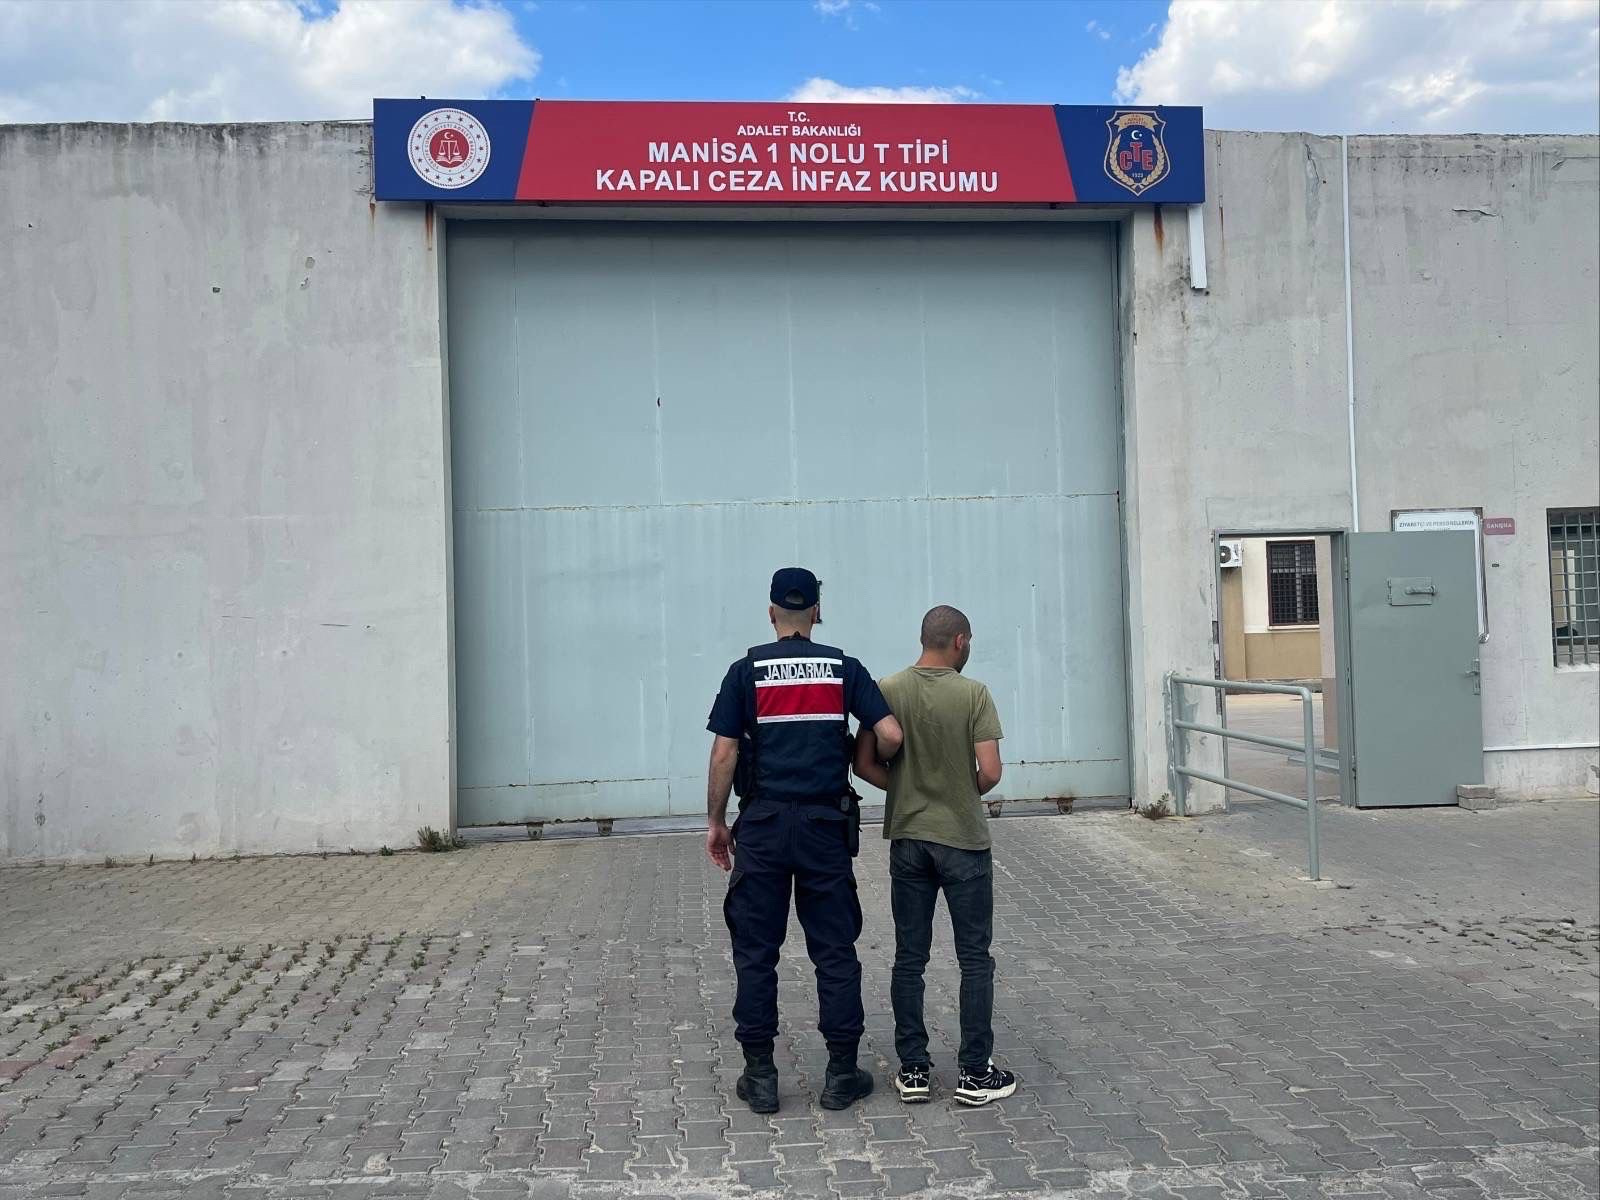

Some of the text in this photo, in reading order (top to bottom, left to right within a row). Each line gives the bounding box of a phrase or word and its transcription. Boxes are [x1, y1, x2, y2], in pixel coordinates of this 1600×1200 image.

[788, 111, 810, 122] T.C.
[737, 124, 861, 136] ADALET BAKANLIĞI
[648, 138, 948, 164] MANİSA 1 NOLU T TİPİ
[596, 166, 998, 192] KAPALI CEZA İNFAZ KURUMU
[764, 663, 834, 680] JANDARMA
